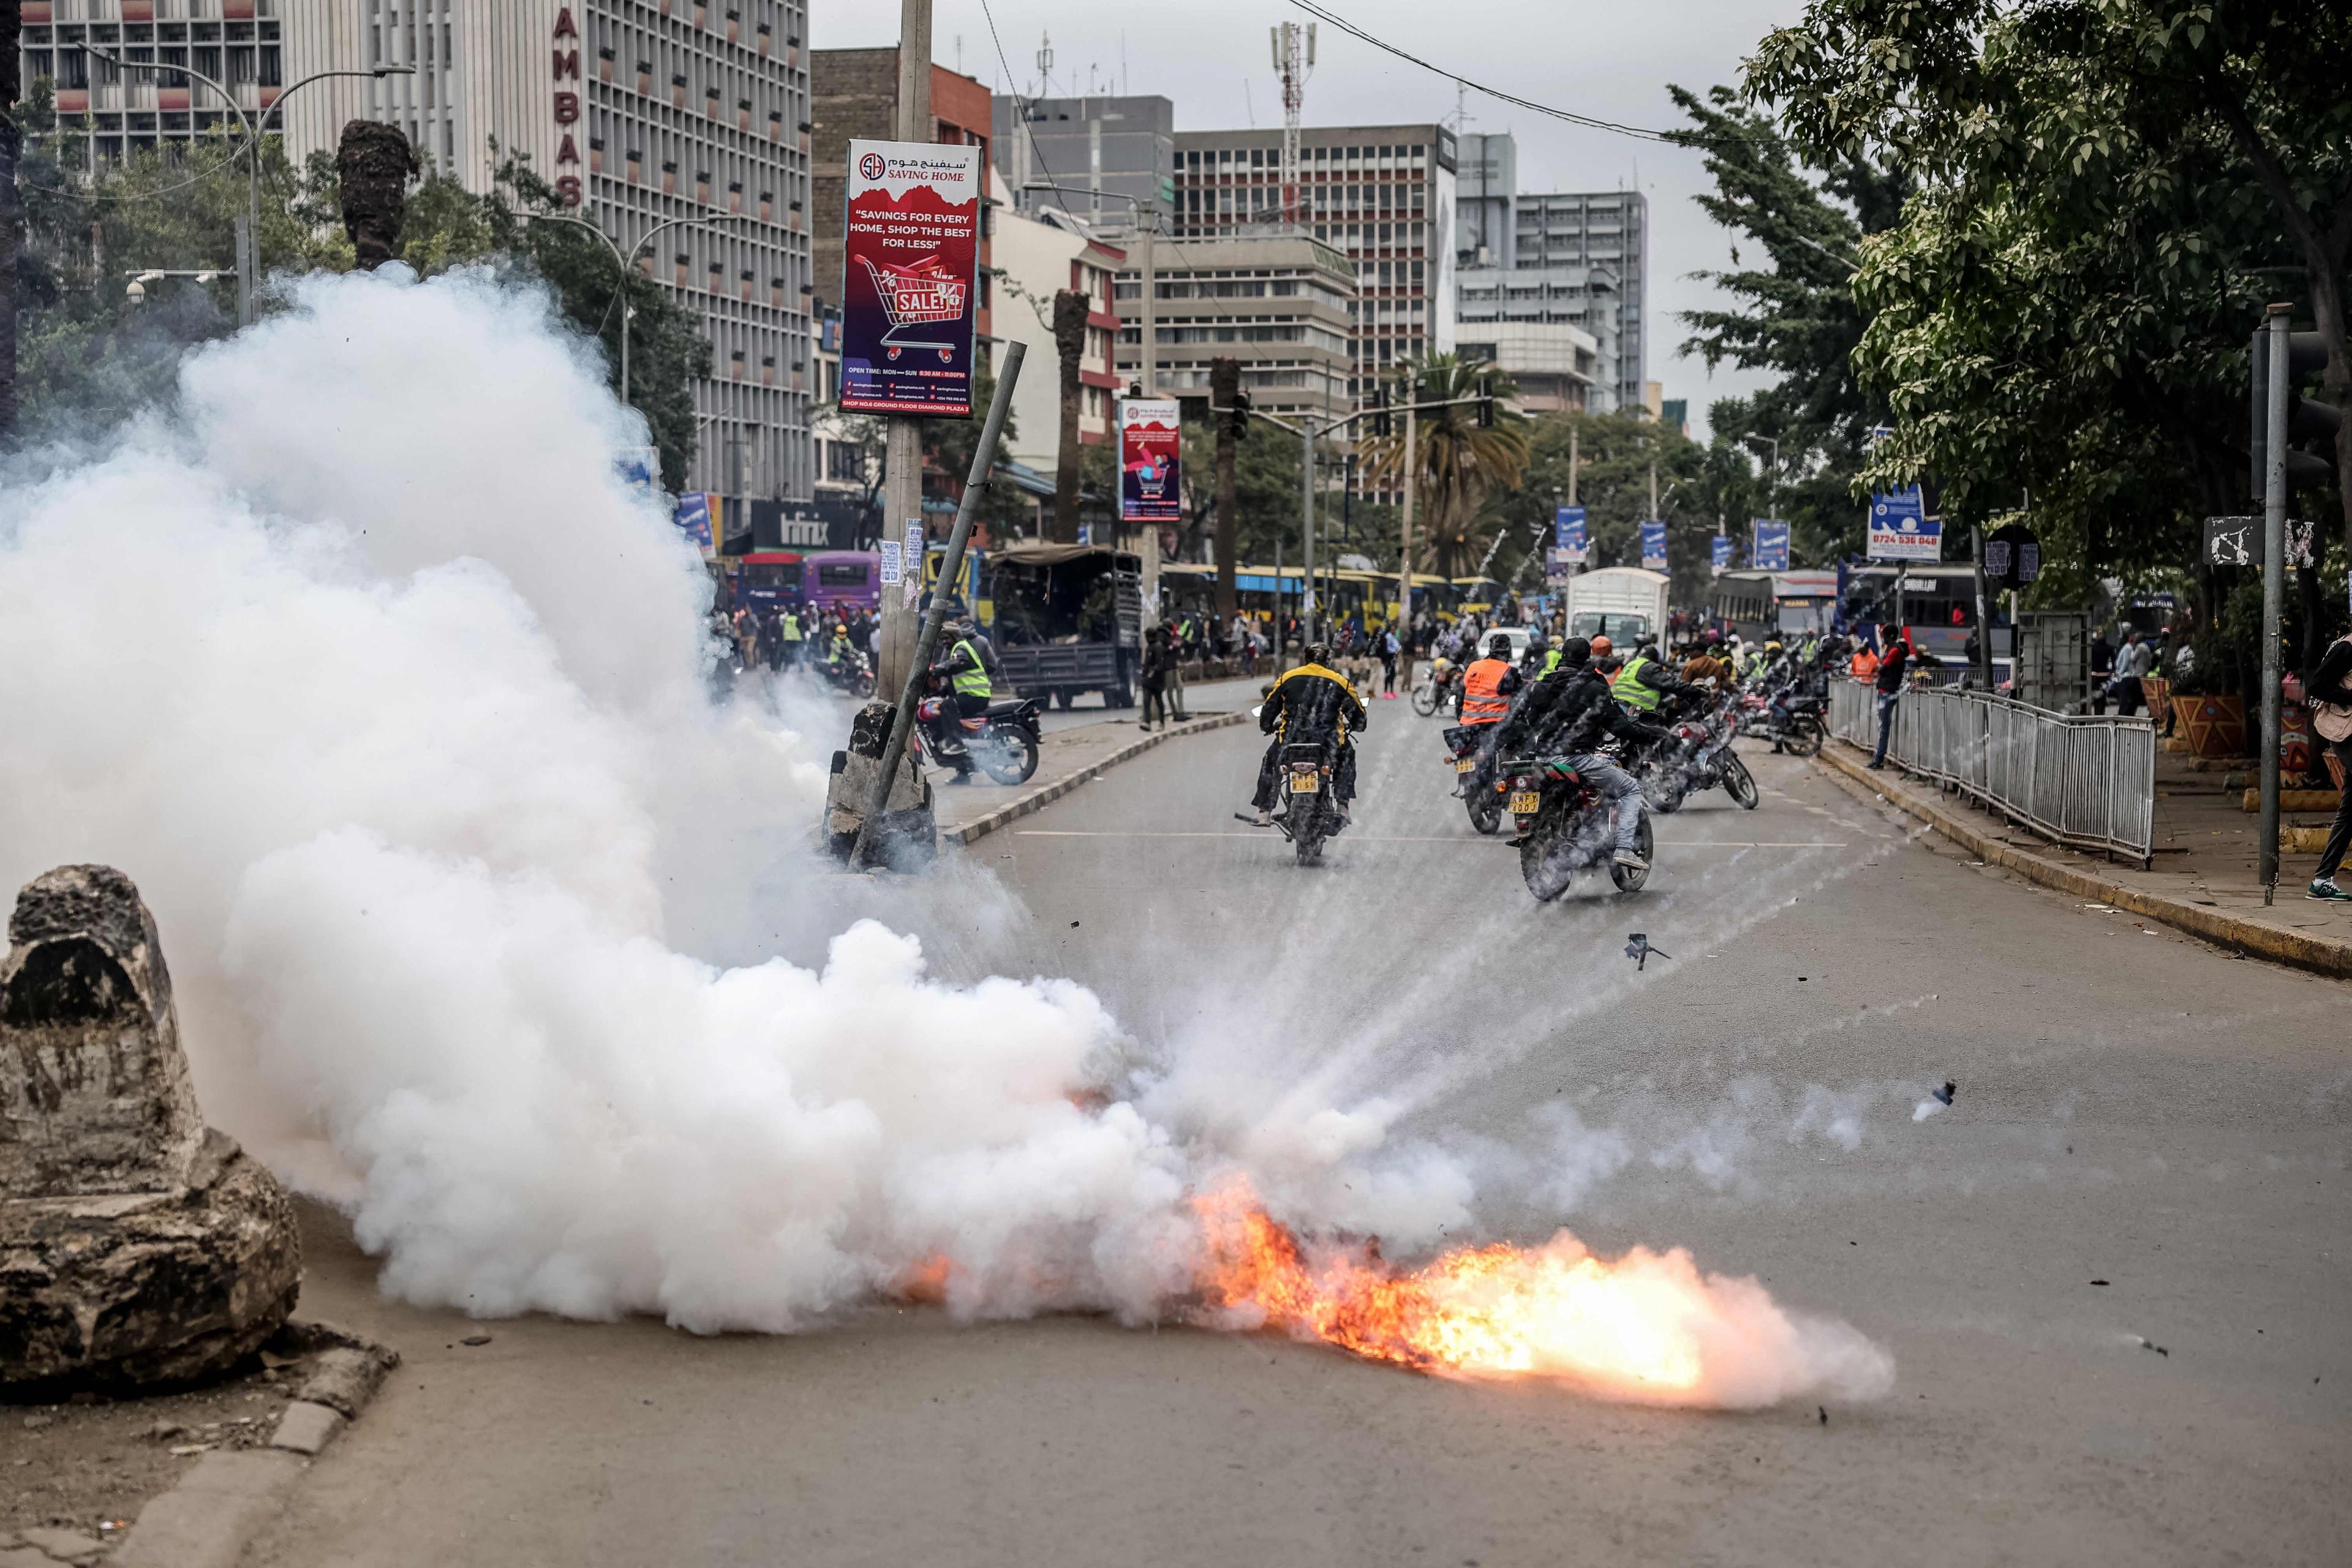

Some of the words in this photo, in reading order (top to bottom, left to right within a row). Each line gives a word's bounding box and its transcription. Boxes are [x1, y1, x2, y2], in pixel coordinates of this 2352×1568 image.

[888, 159, 918, 168] هوم
[888, 170, 928, 180] SAVING
[932, 172, 964, 181] HOME
[856, 209, 907, 221] “SAVINGS
[910, 213, 932, 222] FOR
[935, 214, 969, 224] EVERY
[850, 223, 885, 235] HOME,
[888, 225, 918, 235] SHOP
[921, 227, 941, 236] THE
[944, 228, 971, 237] BEST
[883, 238, 904, 247] FOR
[907, 239, 940, 249] LESS!”
[900, 293, 944, 310] SALE!
